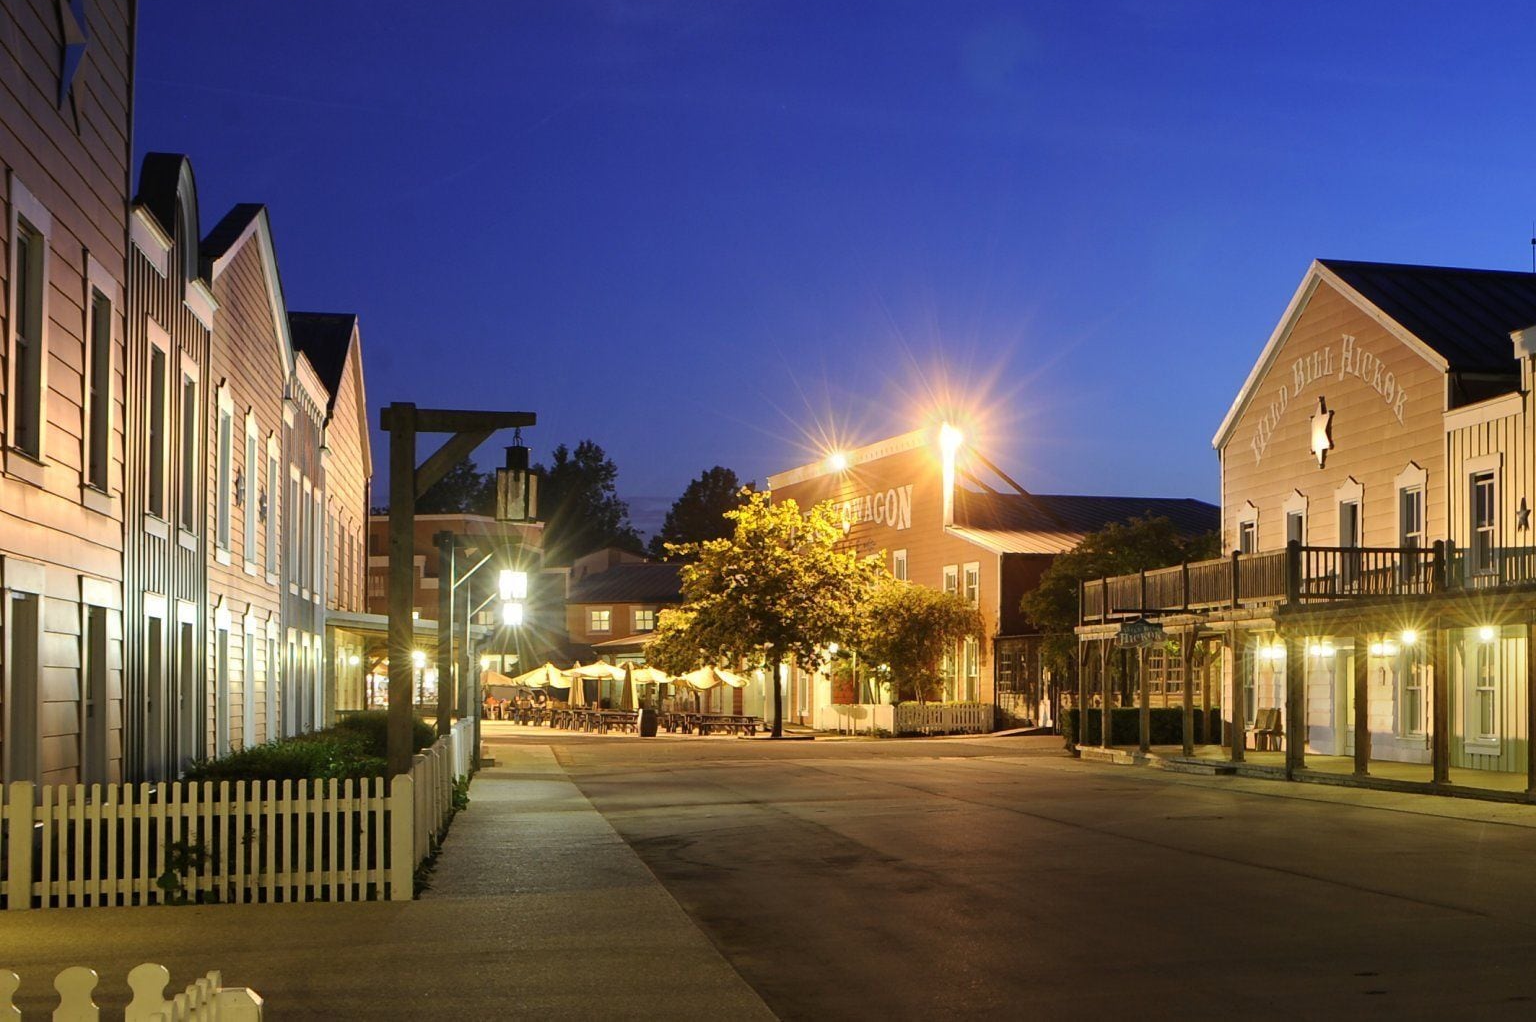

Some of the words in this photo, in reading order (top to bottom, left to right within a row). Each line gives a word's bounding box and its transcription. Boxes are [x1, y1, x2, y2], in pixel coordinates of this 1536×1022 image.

[1250, 385, 1288, 467] WILD
[1292, 346, 1333, 397] BILL
[1338, 333, 1409, 426] HICKOK
